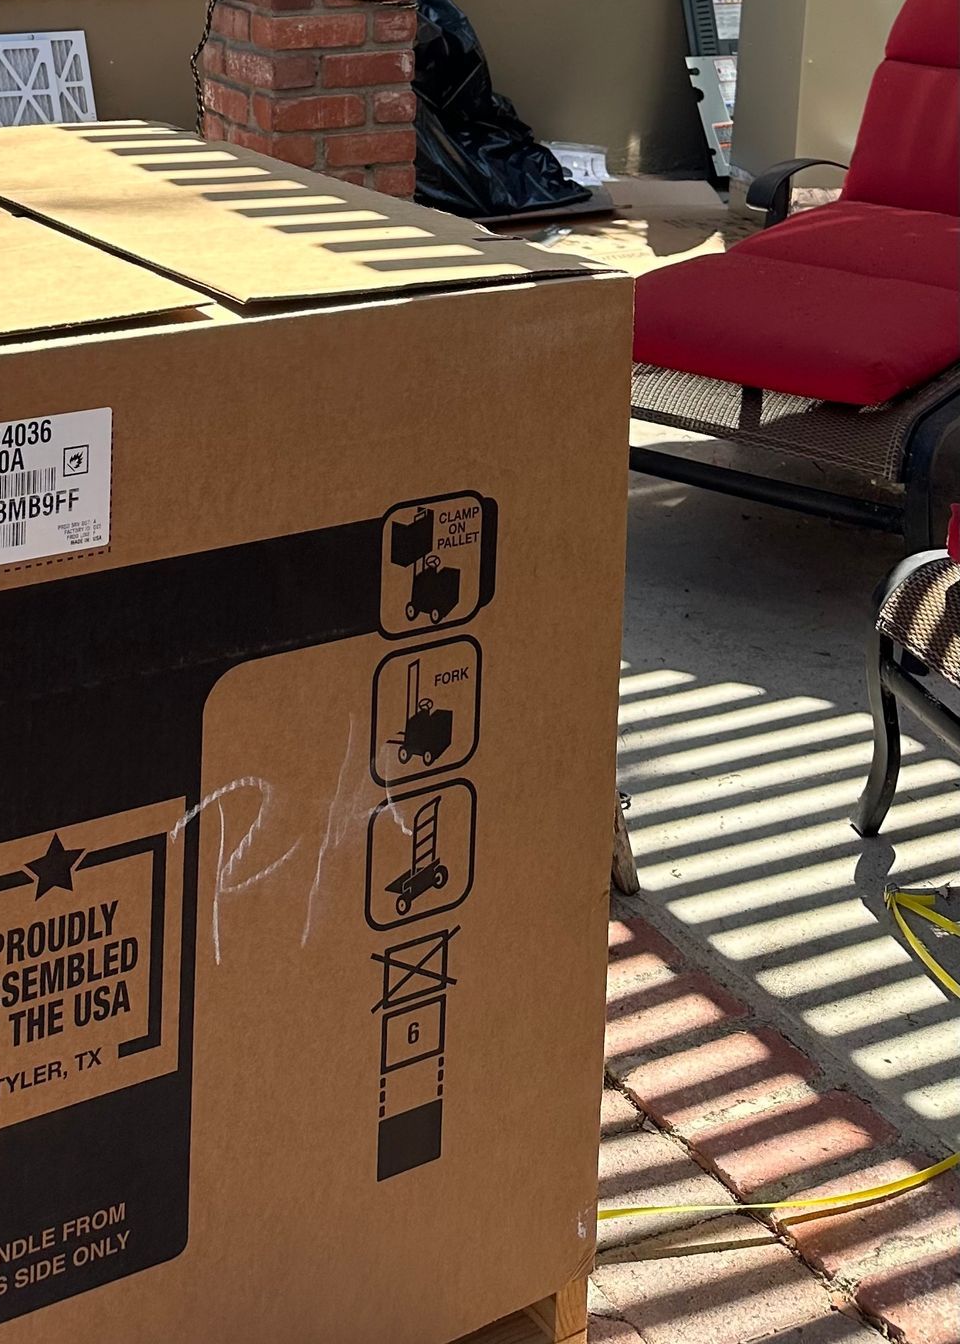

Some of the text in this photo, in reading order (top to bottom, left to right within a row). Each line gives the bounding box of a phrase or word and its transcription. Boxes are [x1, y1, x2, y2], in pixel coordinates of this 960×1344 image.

[438, 506, 480, 524] CLAMP
[448, 521, 466, 535] ON
[437, 531, 480, 550] PALLET
[434, 667, 469, 686] FORK
[9, 1000, 64, 1047] THE
[74, 981, 131, 1027] USA
[407, 1021, 420, 1045] 6
[74, 1047, 103, 1072] TX
[62, 1202, 127, 1241] FROM
[14, 1256, 66, 1289] SIDE
[73, 1230, 131, 1268] ONLY
